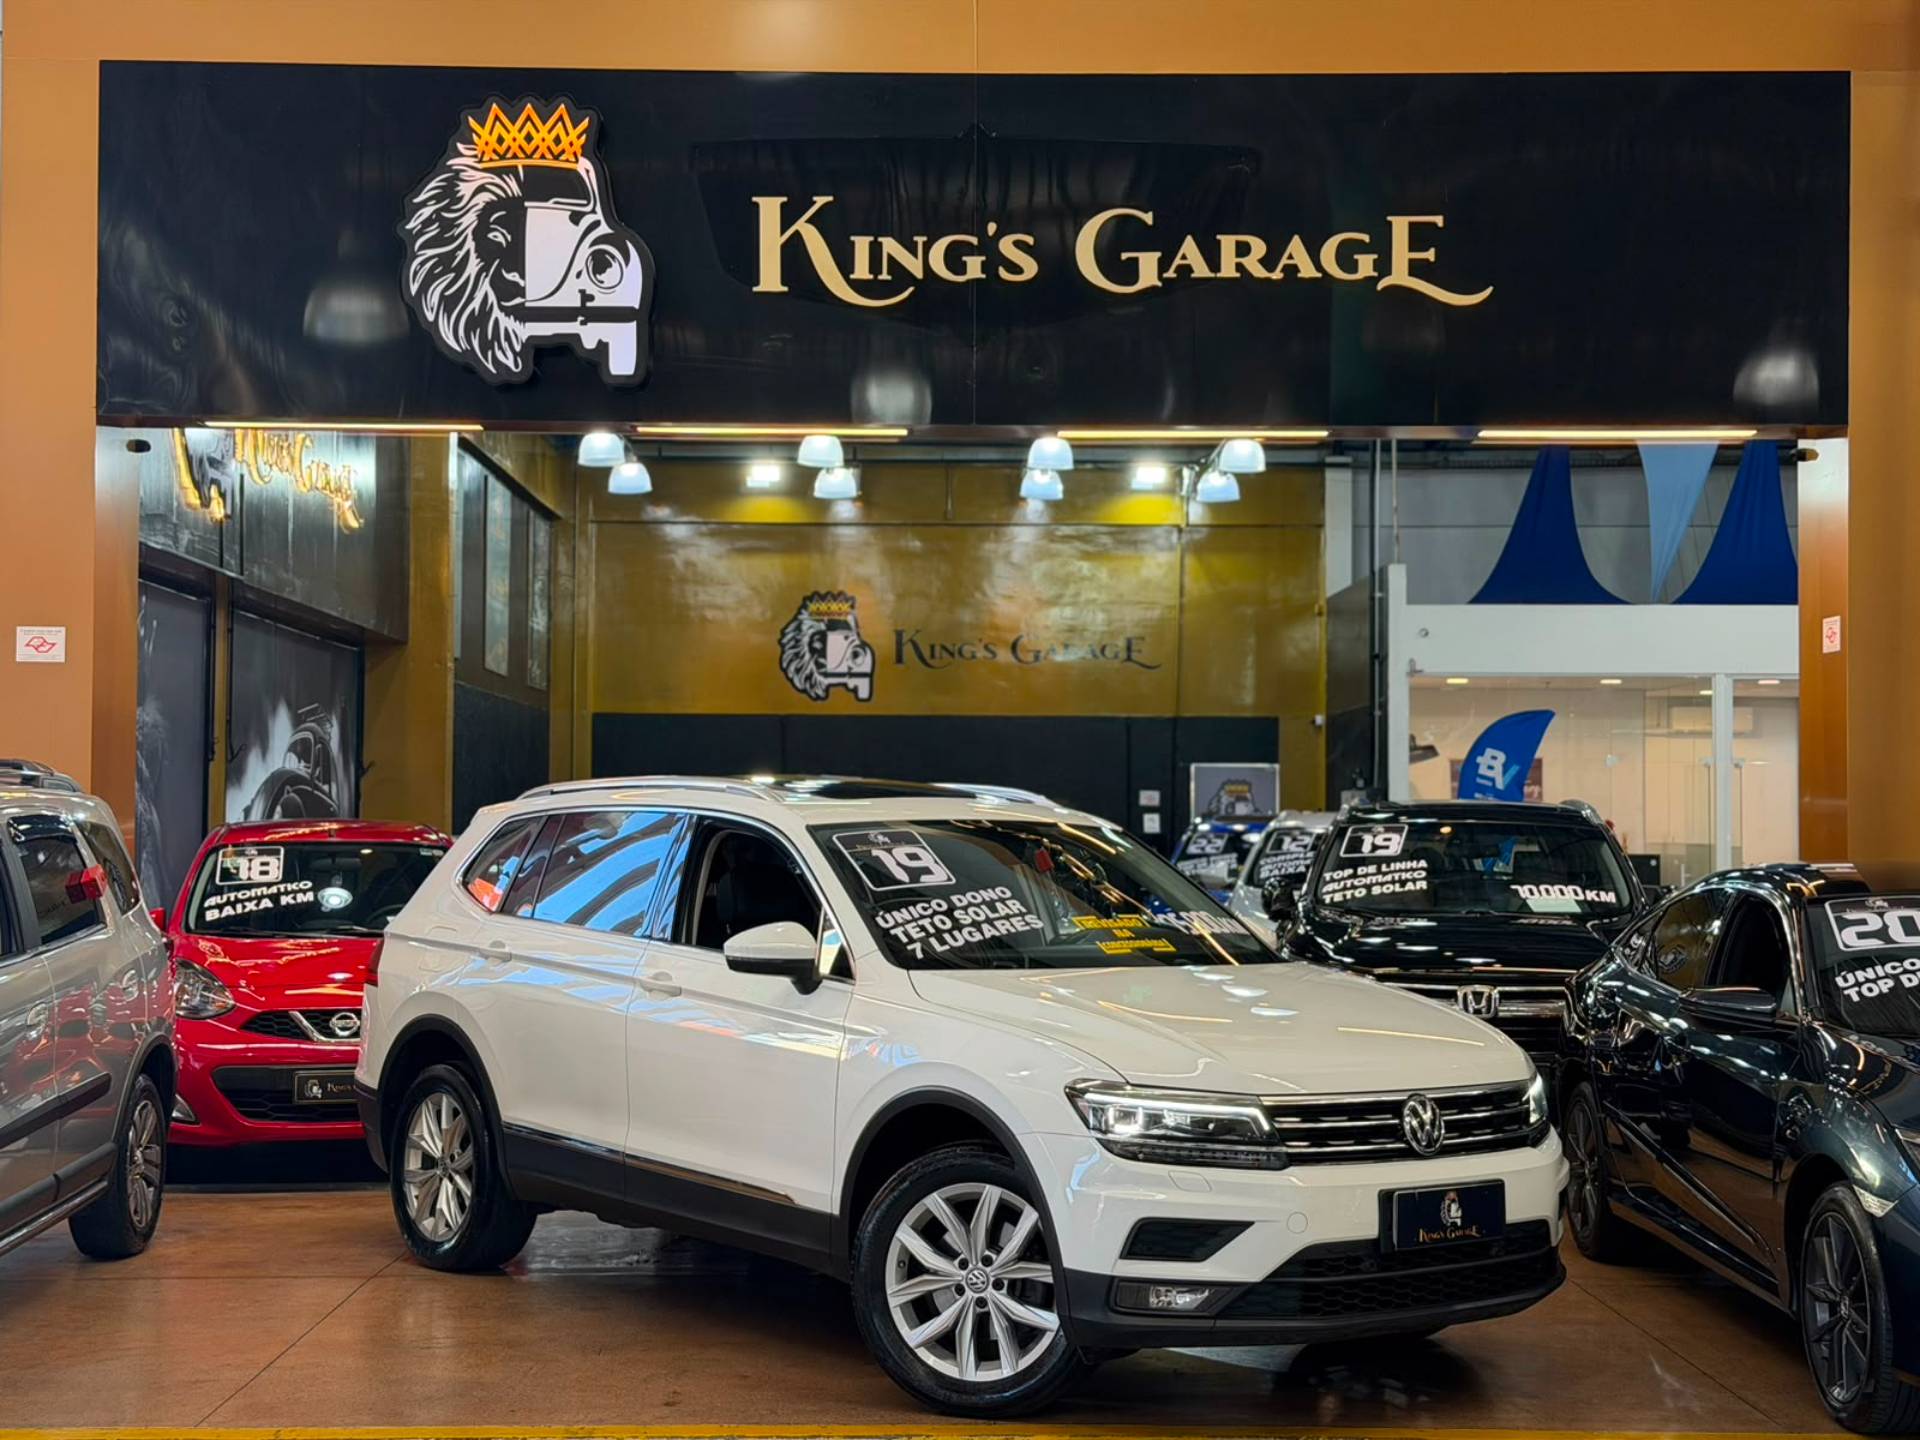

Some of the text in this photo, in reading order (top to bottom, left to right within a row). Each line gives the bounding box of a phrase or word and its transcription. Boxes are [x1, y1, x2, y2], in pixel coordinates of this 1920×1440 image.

[752, 196, 1494, 307] KING'S GARAGE
[893, 629, 997, 669] KING'S
[1361, 833, 1401, 854] 19
[238, 857, 280, 880] 18
[871, 846, 948, 883] 19
[1323, 859, 1428, 881] TOP DE LINHA
[205, 891, 314, 921] BAIXA KM
[875, 886, 1012, 929] ÚNICO DONO
[1322, 880, 1428, 904] TETO SOLAR
[890, 900, 1027, 943] TETO SOLAR
[907, 914, 1044, 959] 7 LUGARES
[1841, 910, 1920, 946] 20
[1835, 958, 1920, 988] ÚNICO
[1843, 971, 1920, 1002] TOP D
